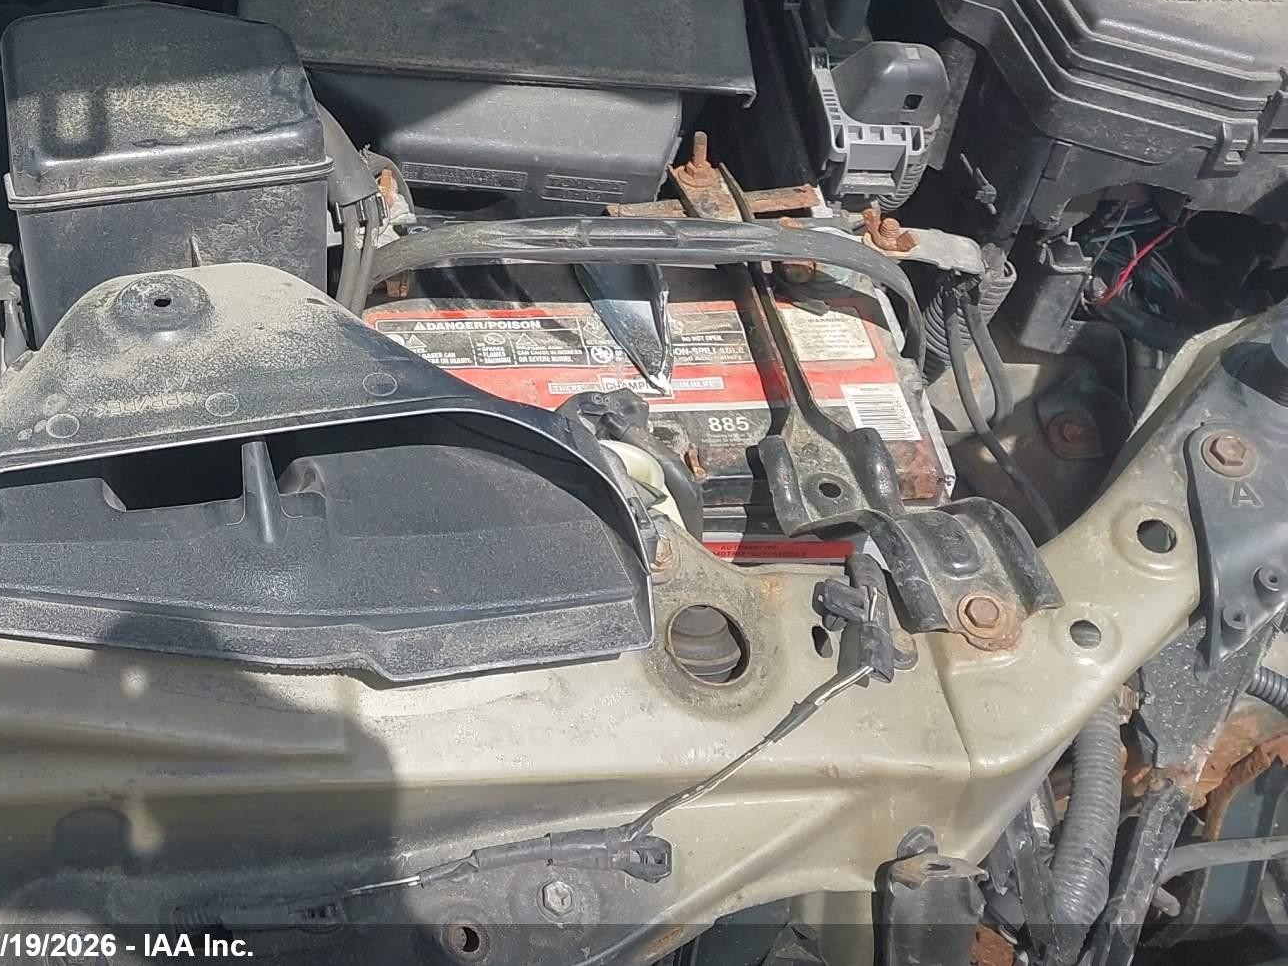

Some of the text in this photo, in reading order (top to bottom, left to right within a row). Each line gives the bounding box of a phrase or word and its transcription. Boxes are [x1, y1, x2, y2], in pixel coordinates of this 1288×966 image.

[426, 320, 541, 331] DANGER/POISON
[671, 347, 745, 356] ON-SPILLABLE
[708, 417, 749, 432] 885
[1231, 481, 1264, 509] A
